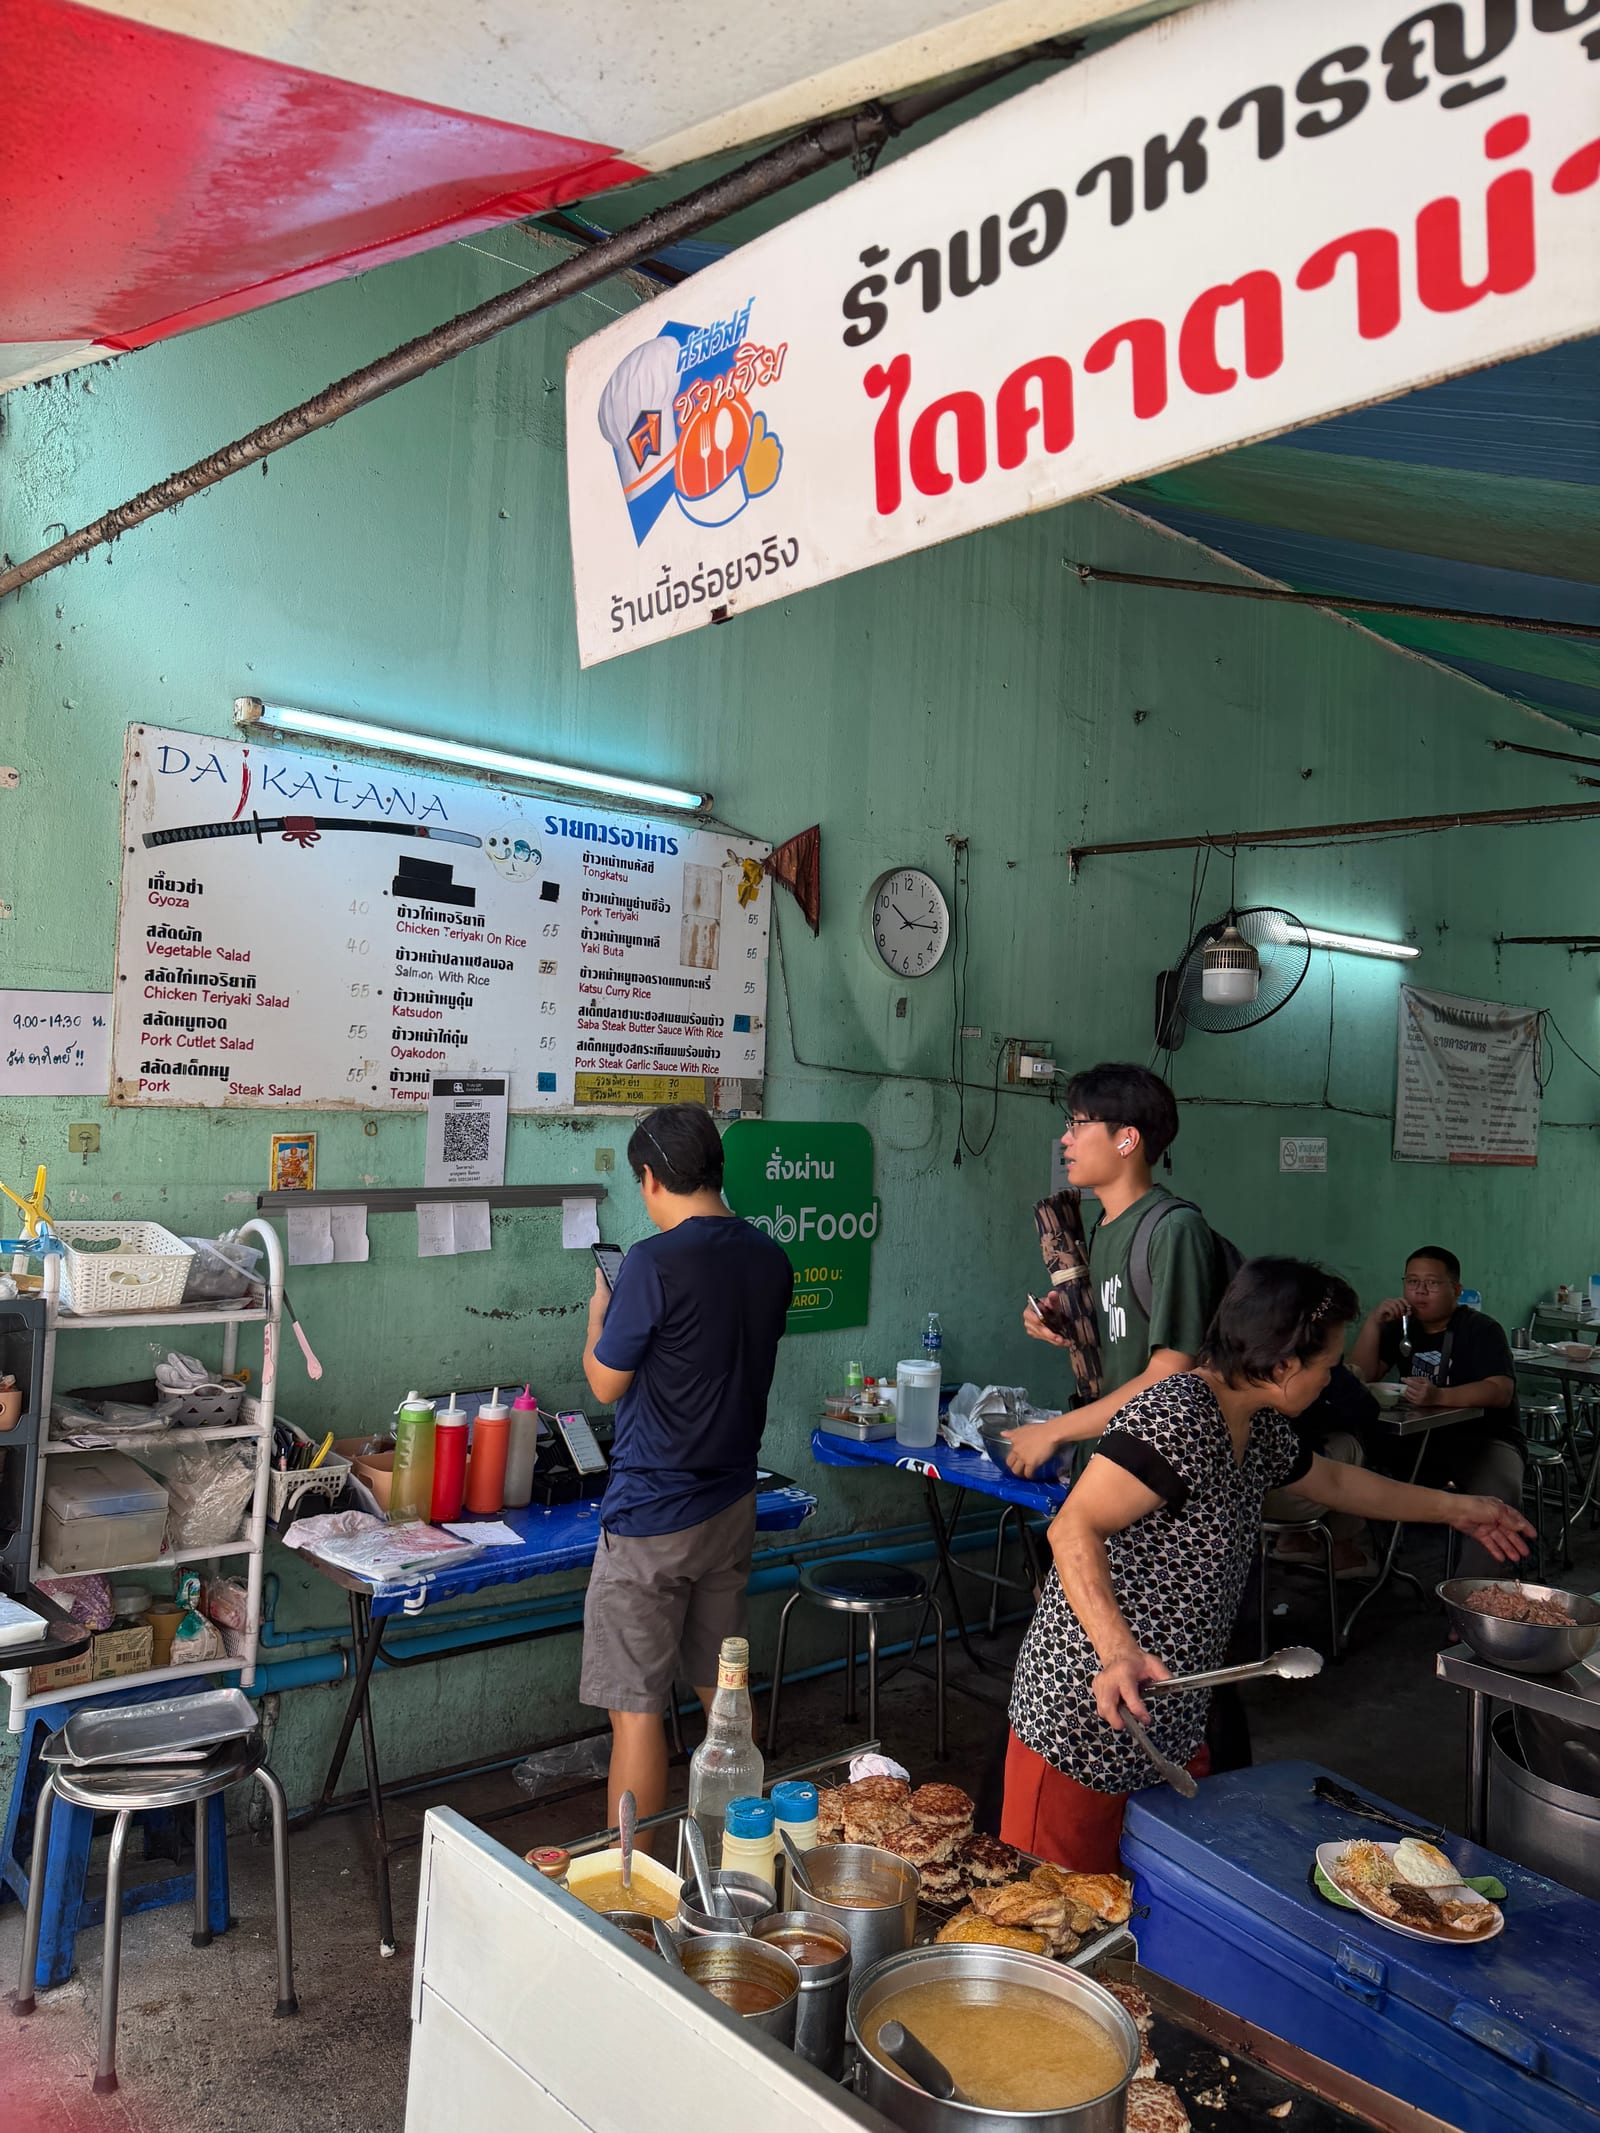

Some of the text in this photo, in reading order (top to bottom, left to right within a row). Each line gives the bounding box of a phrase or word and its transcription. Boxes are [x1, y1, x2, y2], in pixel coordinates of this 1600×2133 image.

[674, 342, 788, 426] ชวนชิม
[609, 535, 800, 633] ร้านนี้อร่อยจริง
[544, 815, 679, 856] รายการอาหาร
[582, 864, 629, 883] Tongkatsu
[891, 881, 899, 895] 11
[904, 877, 914, 891] 12
[920, 885, 925, 898] 1
[148, 891, 190, 909] Gyoza
[880, 895, 890, 909] 10
[928, 900, 935, 914] 2
[581, 904, 639, 922] Pork Teriyaki
[875, 913, 881, 927] 9
[146, 922, 203, 943] สลัดผัก
[395, 920, 440, 937] Chicken
[486, 932, 502, 945] On
[505, 934, 527, 949] Rice
[931, 921, 939, 934] 3
[345, 937, 371, 956] 40
[580, 926, 661, 950] ข้าวหน้าหมูเกาหลี
[878, 934, 886, 947] 8
[926, 940, 934, 953] 4
[146, 941, 212, 959] Vegetable
[581, 942, 625, 958] Yaki Buta
[891, 950, 898, 963] 7
[902, 956, 910, 970] 6
[916, 953, 924, 966] 5
[144, 967, 257, 989] สลัดไก่เทอริยากิ
[394, 964, 491, 987] Salmon With Rice
[579, 965, 712, 991] ข้าวหน้าหมูทอดราดแกงกะหรี่
[350, 982, 371, 999] 55
[578, 982, 652, 999] Katsu Curry Rice
[743, 981, 756, 995] 55
[143, 985, 290, 1009] Chicken Teriyaki Salad
[391, 1005, 443, 1020] Katsudon
[539, 1001, 557, 1016] 55
[142, 1010, 228, 1033] สลัดหมูทอด
[577, 1018, 724, 1039] Saba Steak Butter Sauce With Rice
[347, 1024, 369, 1040] 55
[140, 1032, 255, 1051] Pork Cutlet Salad
[539, 1036, 557, 1051] 55
[390, 1045, 446, 1061] Oyakodon
[743, 1049, 757, 1061] 55
[139, 1058, 231, 1082] สลัดสเต็กหมู
[575, 1056, 720, 1075] Pork Steak Garlic Sauce With Rice
[345, 1067, 365, 1083] 55
[389, 1067, 430, 1084] ข้าวหน้
[138, 1078, 302, 1098] Pork Steak Salad
[765, 1147, 835, 1180] สั่งผ่าน
[744, 1202, 878, 1243] abFood
[804, 1266, 828, 1283] 100
